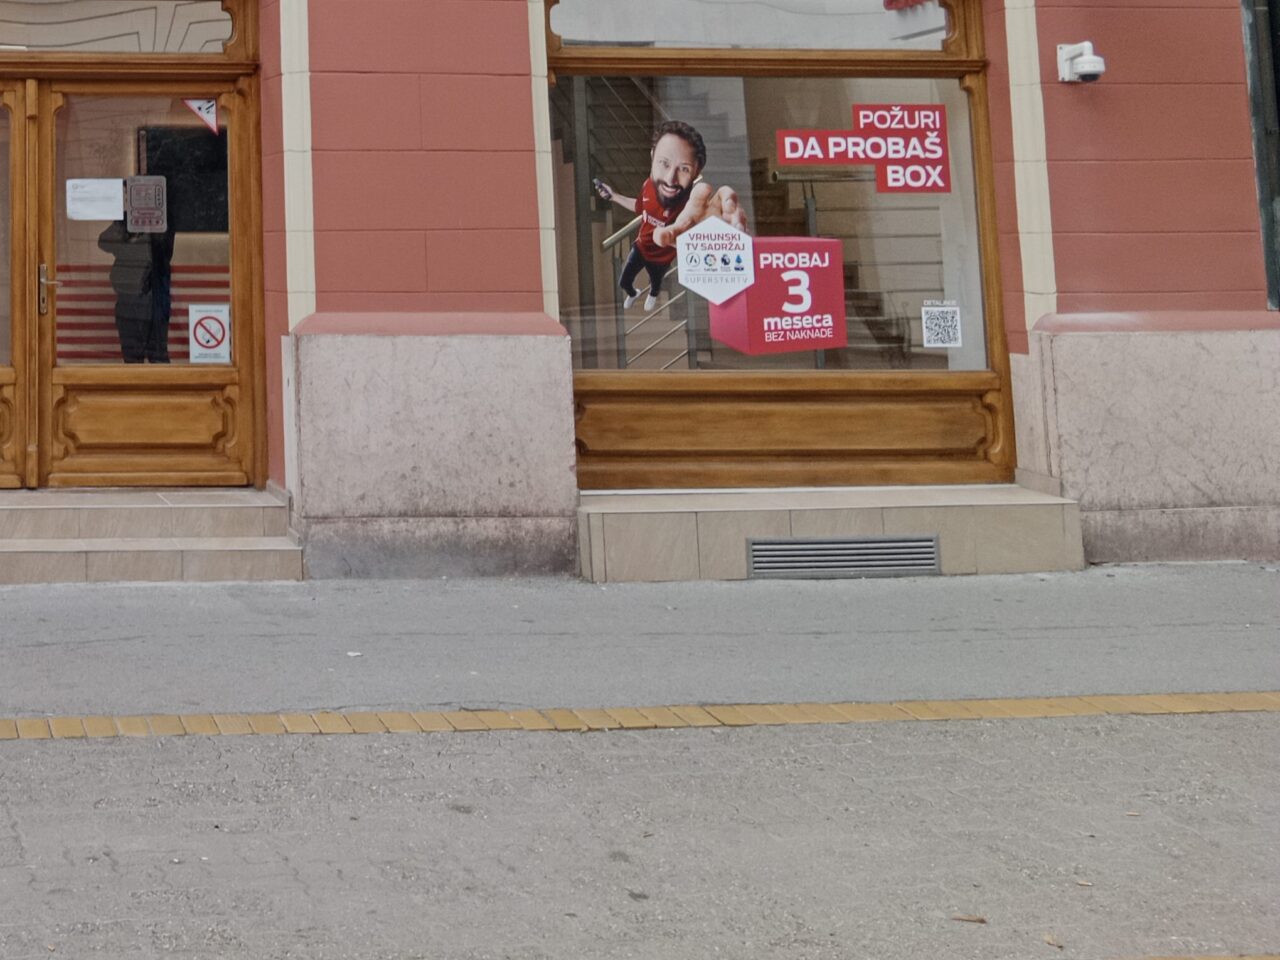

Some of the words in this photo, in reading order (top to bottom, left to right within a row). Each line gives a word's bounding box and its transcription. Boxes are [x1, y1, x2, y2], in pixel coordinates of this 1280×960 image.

[859, 106, 940, 129] POŽURI
[784, 136, 824, 159] DA
[828, 131, 943, 159] PROBAŠ
[886, 165, 945, 187] BOX
[688, 233, 741, 241] VRHUNSKI
[686, 243, 699, 251] TV
[700, 242, 745, 251] SADRŽAJ
[759, 252, 829, 269] PROBAJ
[781, 269, 812, 314] 3
[763, 313, 833, 331] meseca
[765, 331, 785, 342] BEZ
[786, 327, 833, 340] NAKNADE
